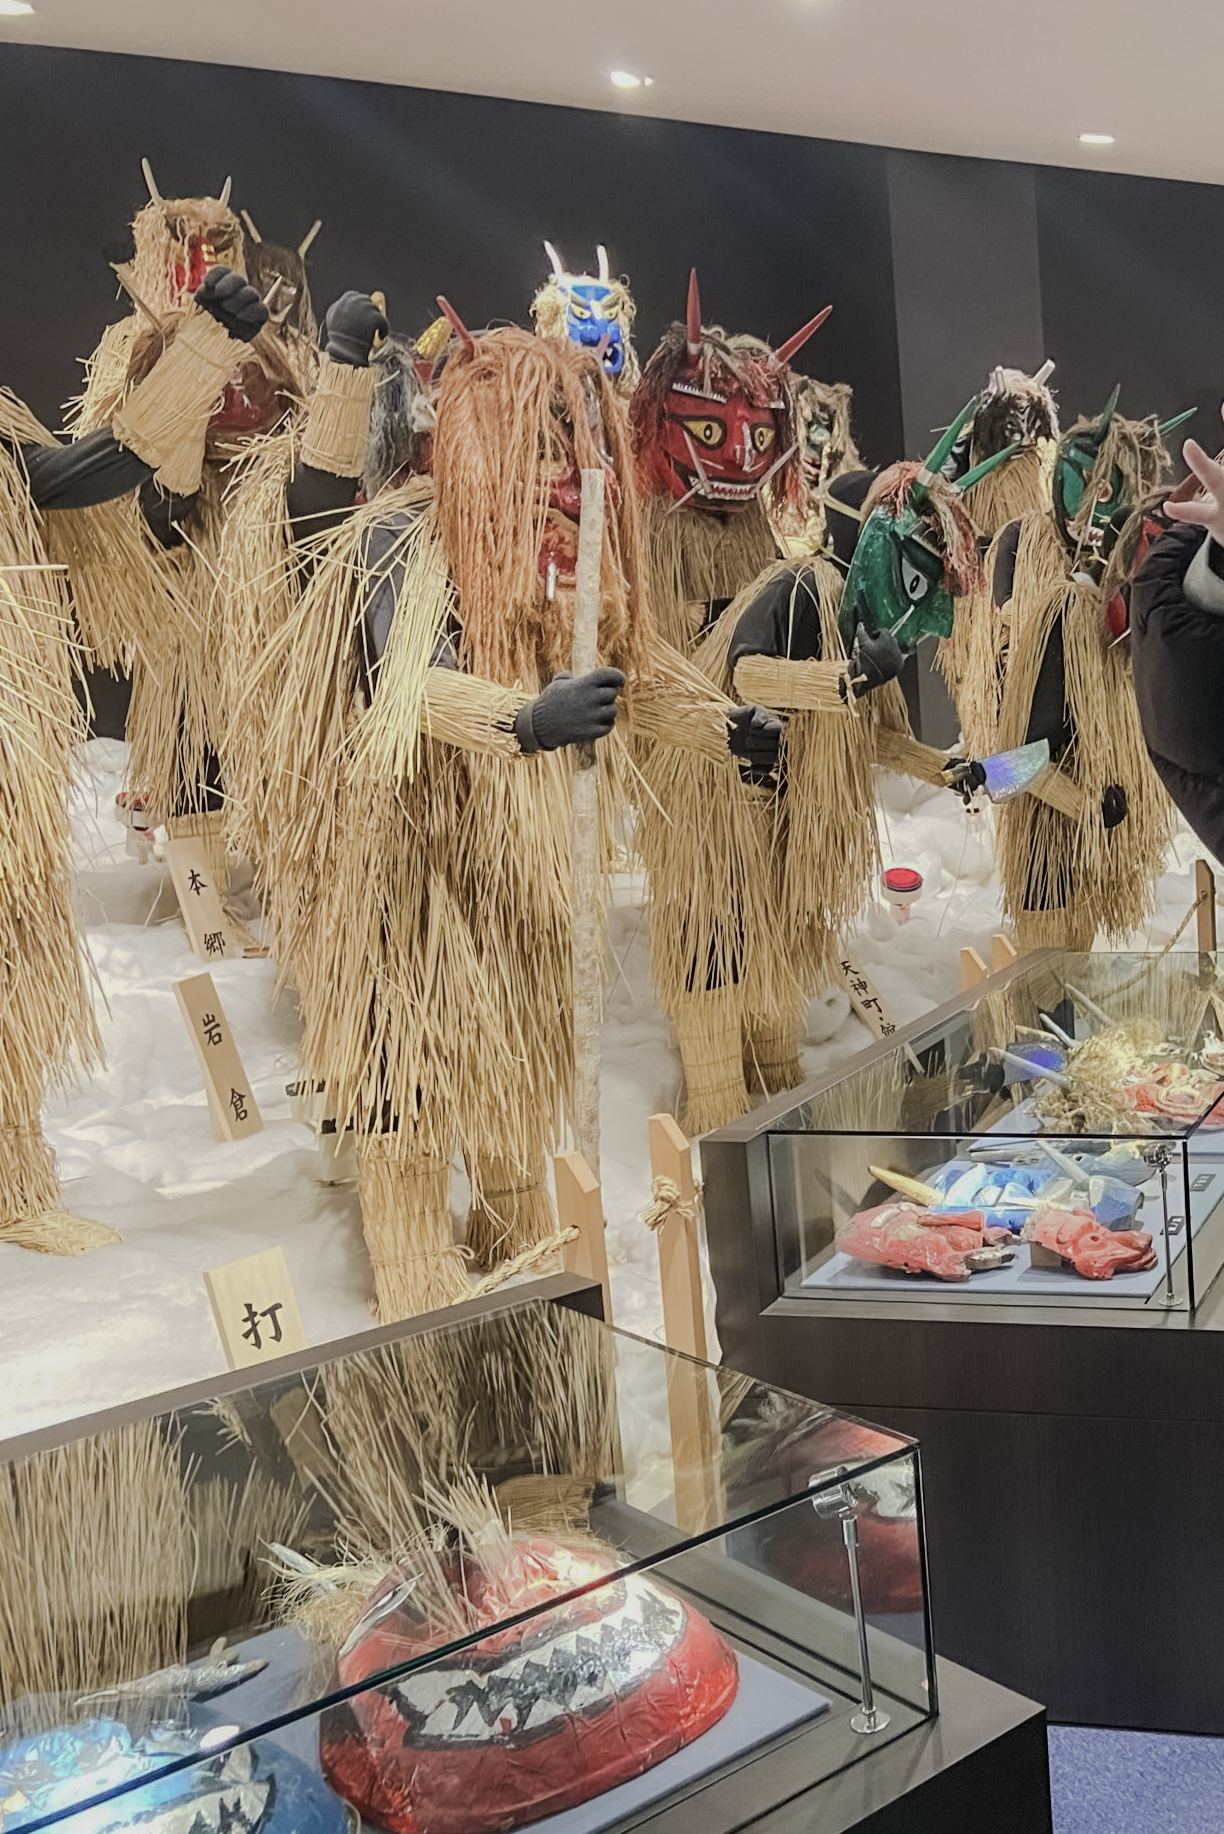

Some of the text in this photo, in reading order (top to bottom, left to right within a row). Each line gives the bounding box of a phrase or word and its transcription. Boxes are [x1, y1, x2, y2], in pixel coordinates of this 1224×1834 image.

[188, 868, 226, 957] 本郷
[202, 1013, 249, 1123] 岩倉
[241, 1302, 283, 1350] 打
